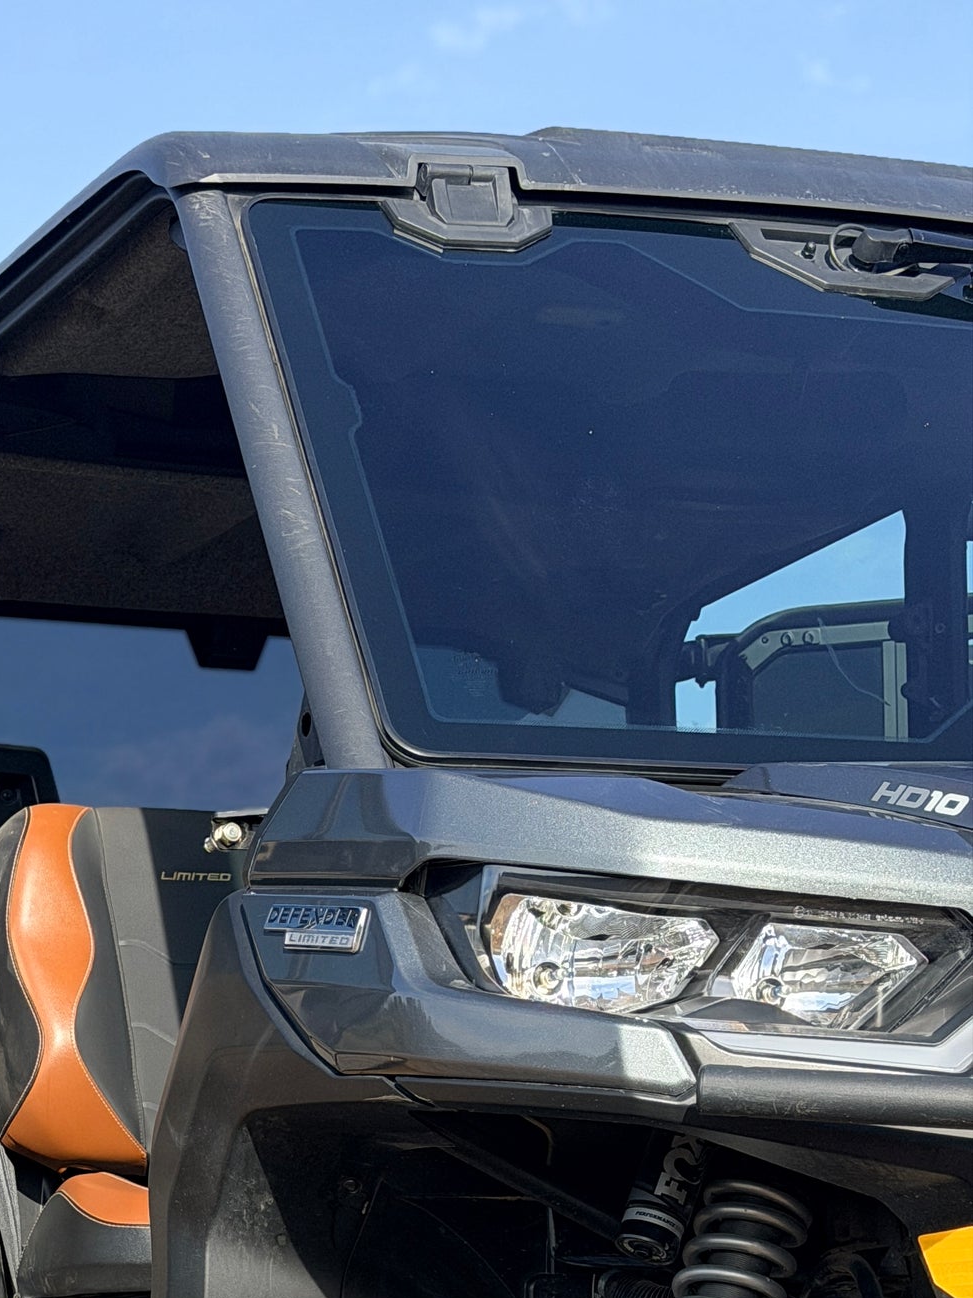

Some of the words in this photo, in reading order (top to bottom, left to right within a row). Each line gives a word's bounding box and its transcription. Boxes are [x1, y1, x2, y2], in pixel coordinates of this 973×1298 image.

[871, 781, 970, 816] HD10
[160, 871, 232, 882] LIMITED
[266, 906, 360, 928] DEFENDER
[288, 932, 351, 946] LIMITED
[653, 1134, 702, 1206] FOX
